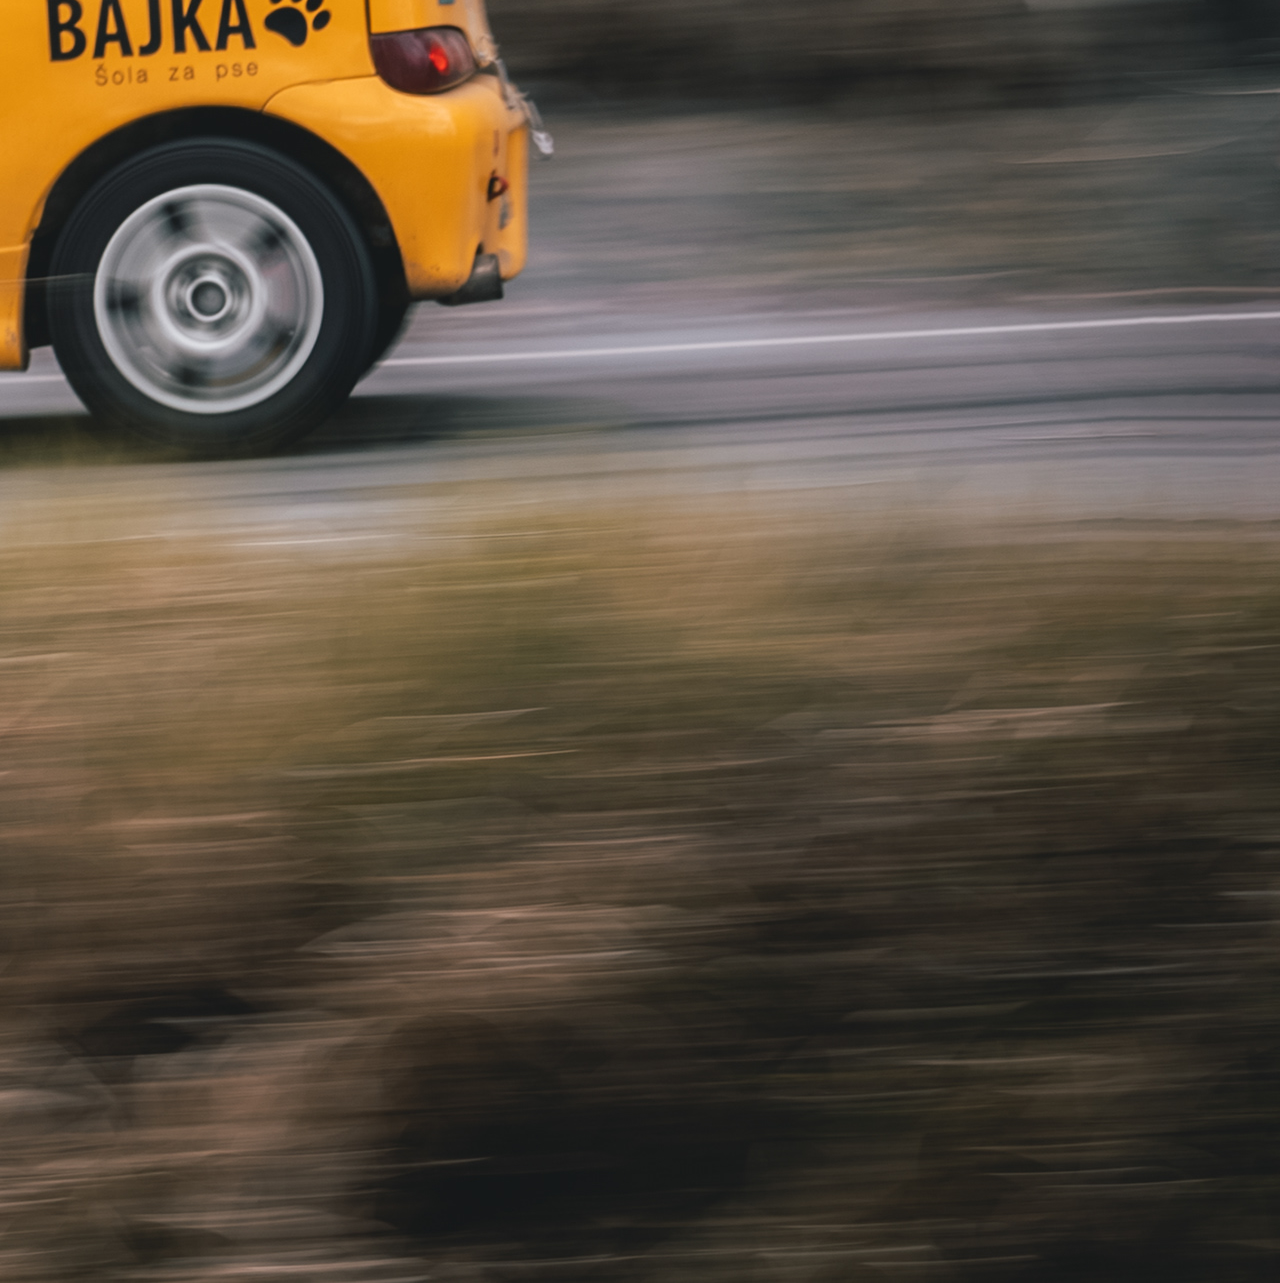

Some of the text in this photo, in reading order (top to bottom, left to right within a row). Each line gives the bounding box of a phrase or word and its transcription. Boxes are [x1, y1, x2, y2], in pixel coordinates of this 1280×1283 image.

[95, 61, 260, 86] Šola za pse
